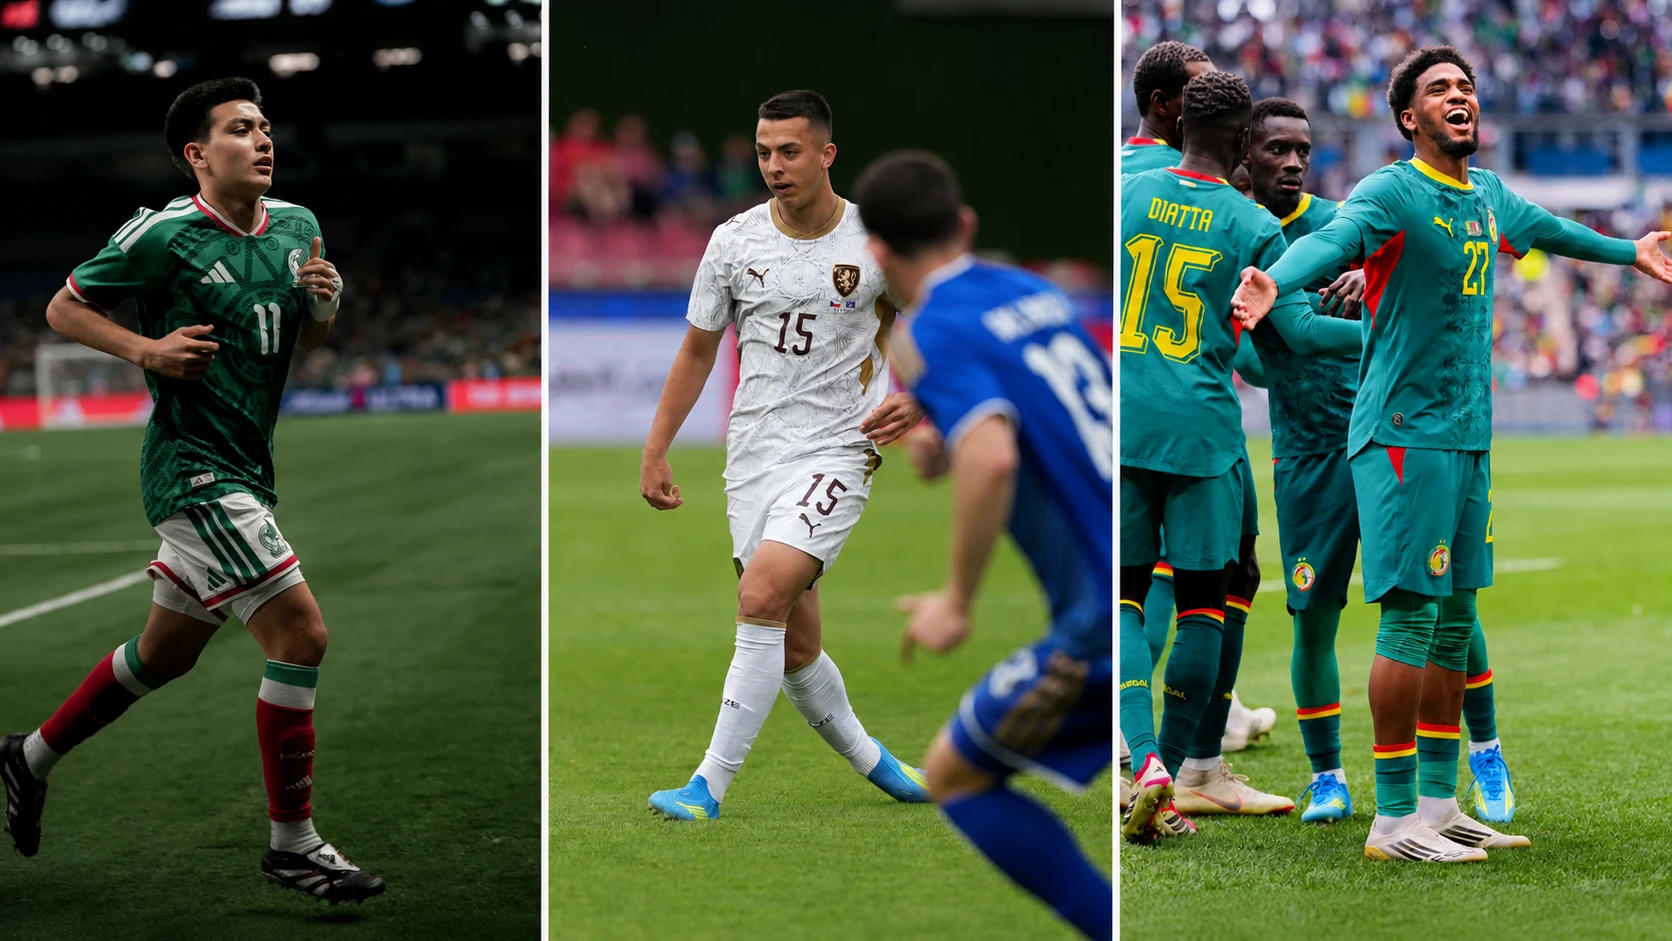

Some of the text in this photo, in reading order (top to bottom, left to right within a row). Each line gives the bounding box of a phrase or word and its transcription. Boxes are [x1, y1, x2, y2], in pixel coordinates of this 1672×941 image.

[1148, 197, 1213, 232] DIATTA
[1462, 240, 1489, 296] 27
[1119, 233, 1223, 364] 15
[253, 302, 281, 355] 11
[774, 311, 817, 356] 15
[796, 473, 848, 516] 15
